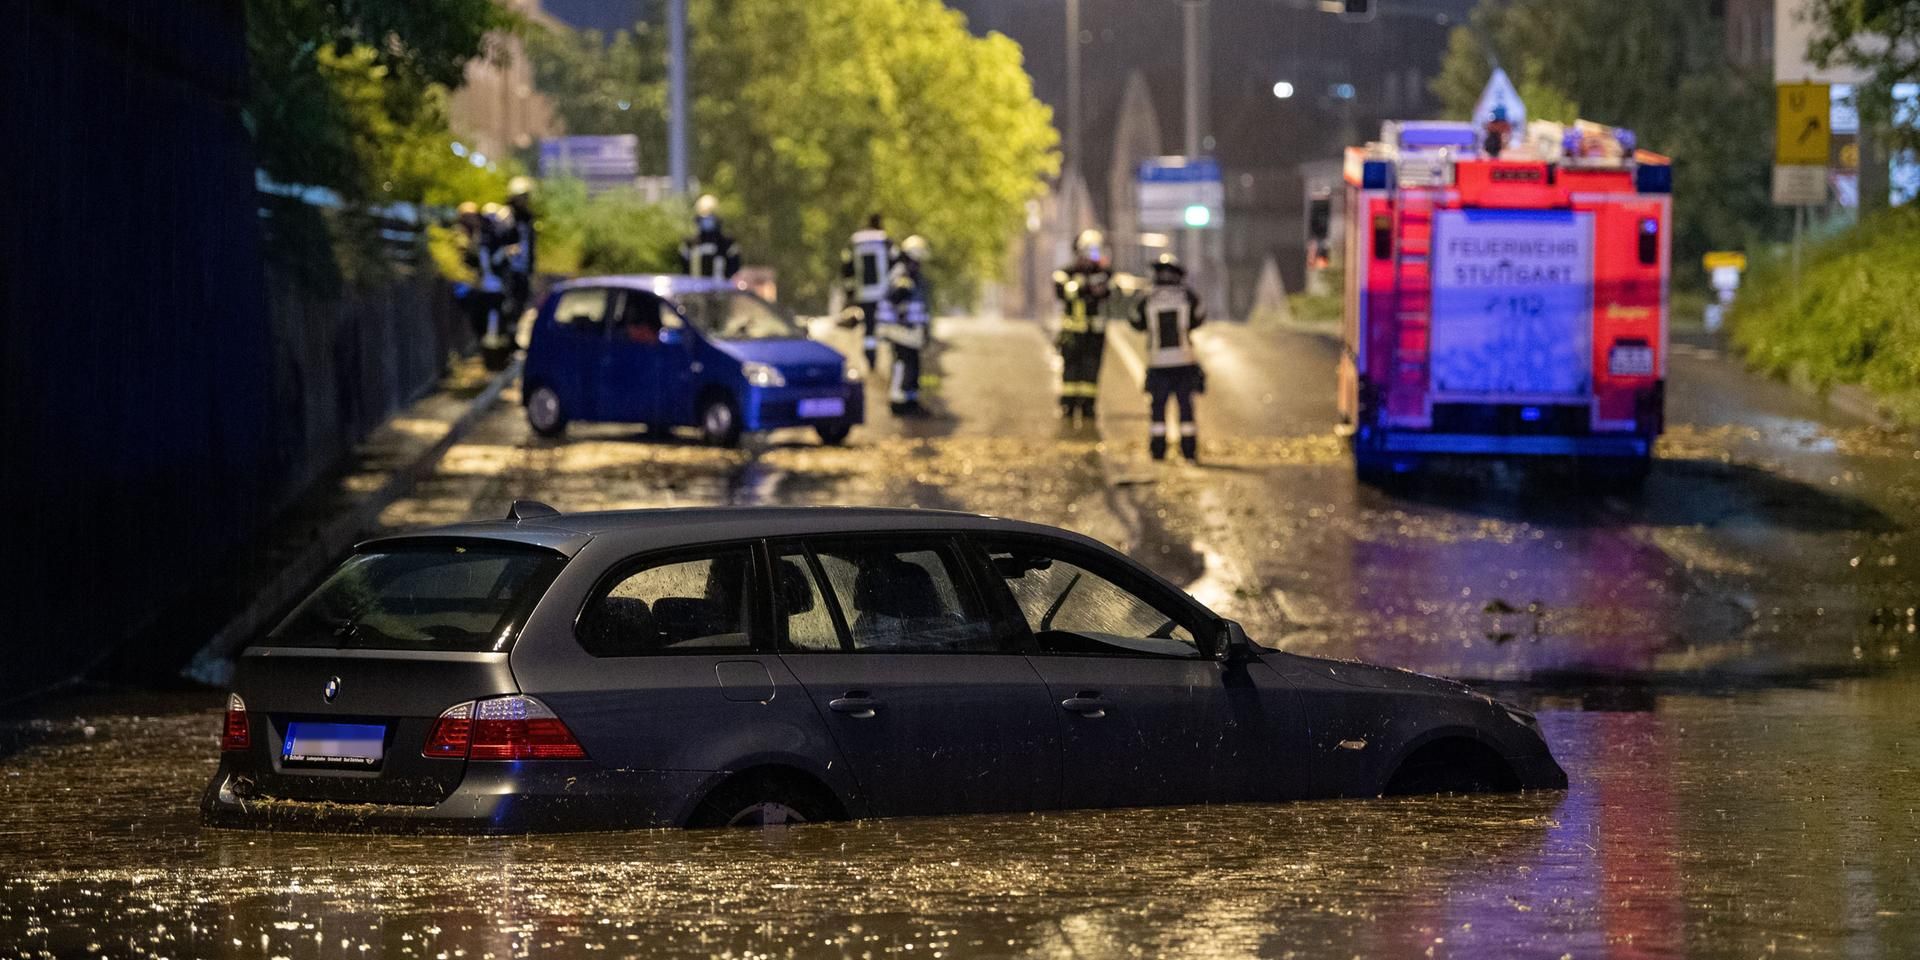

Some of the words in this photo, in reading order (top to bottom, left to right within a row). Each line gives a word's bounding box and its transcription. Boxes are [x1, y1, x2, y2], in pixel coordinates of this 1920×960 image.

[1448, 236, 1578, 256] FEUERWEHR
[1455, 261, 1573, 284] STUTTGART
[1506, 294, 1545, 316] 112
